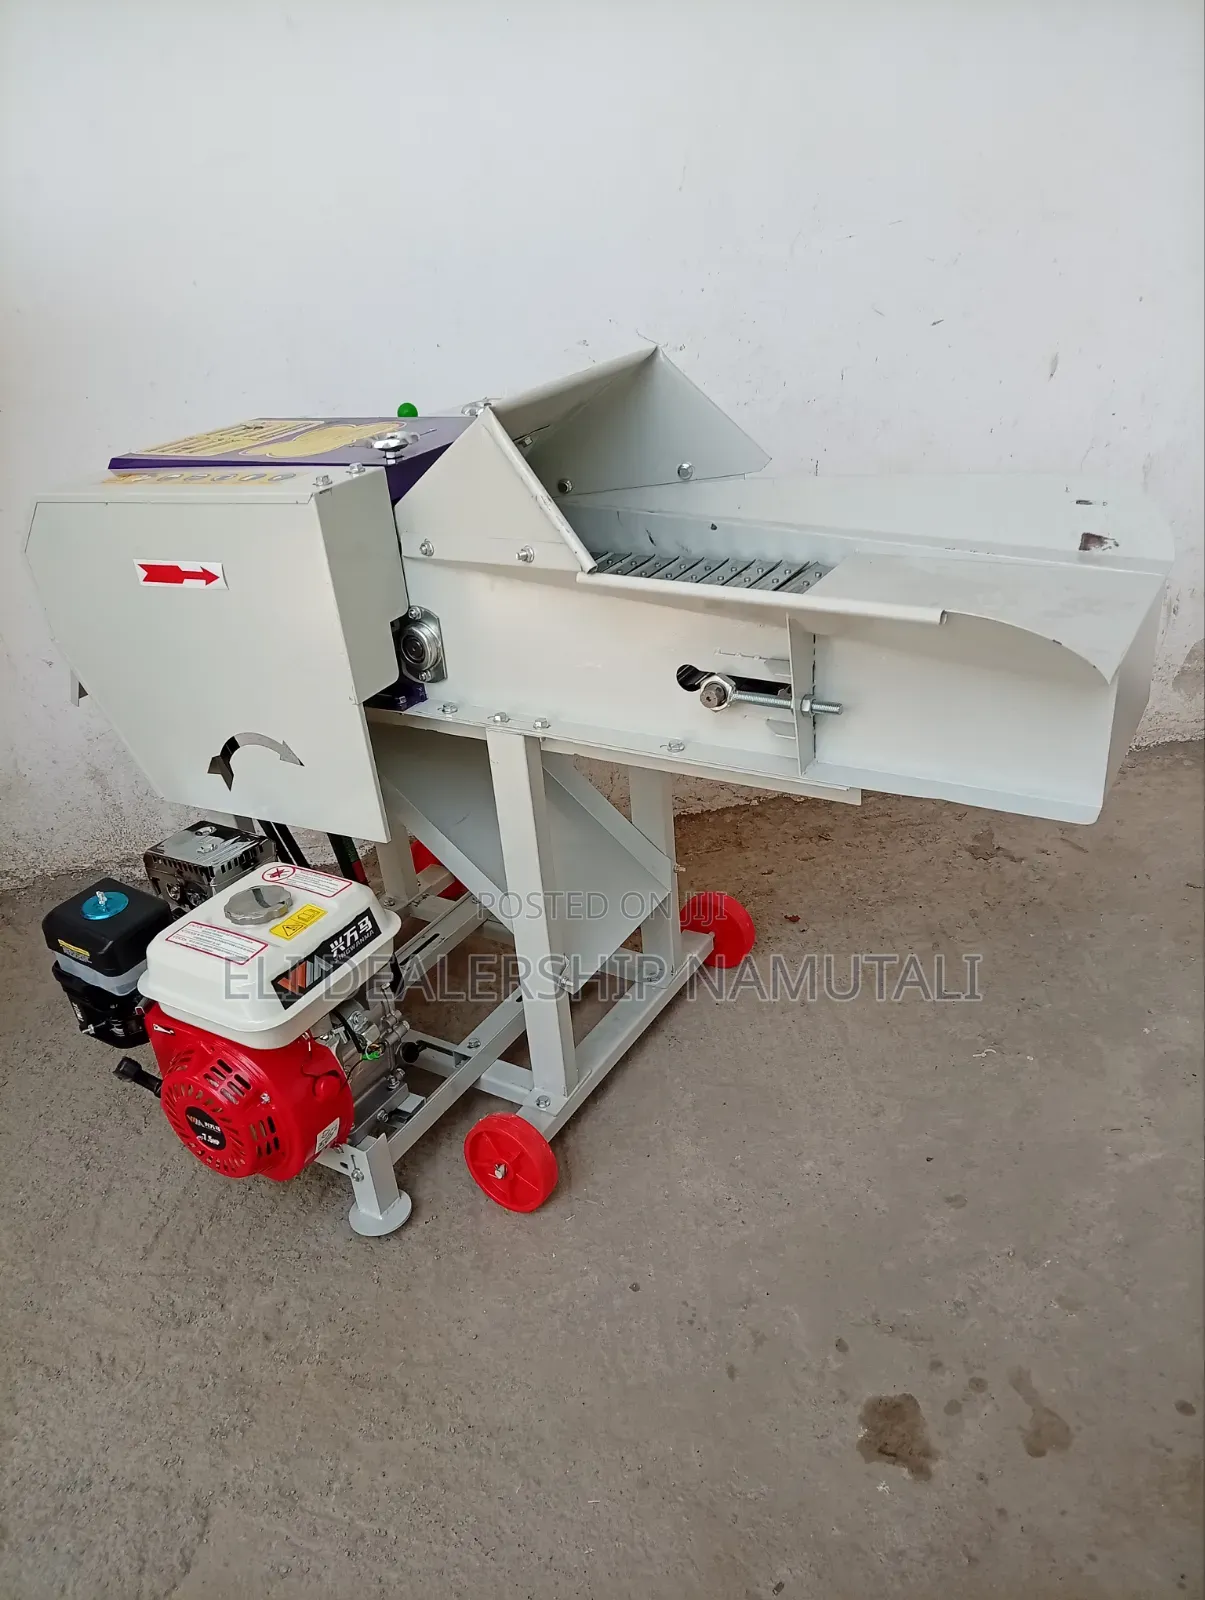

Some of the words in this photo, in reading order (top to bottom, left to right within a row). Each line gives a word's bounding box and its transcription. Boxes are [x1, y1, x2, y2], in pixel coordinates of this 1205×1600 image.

[329, 915, 373, 958] 兴万马
[333, 929, 375, 964] XINGWANMA
